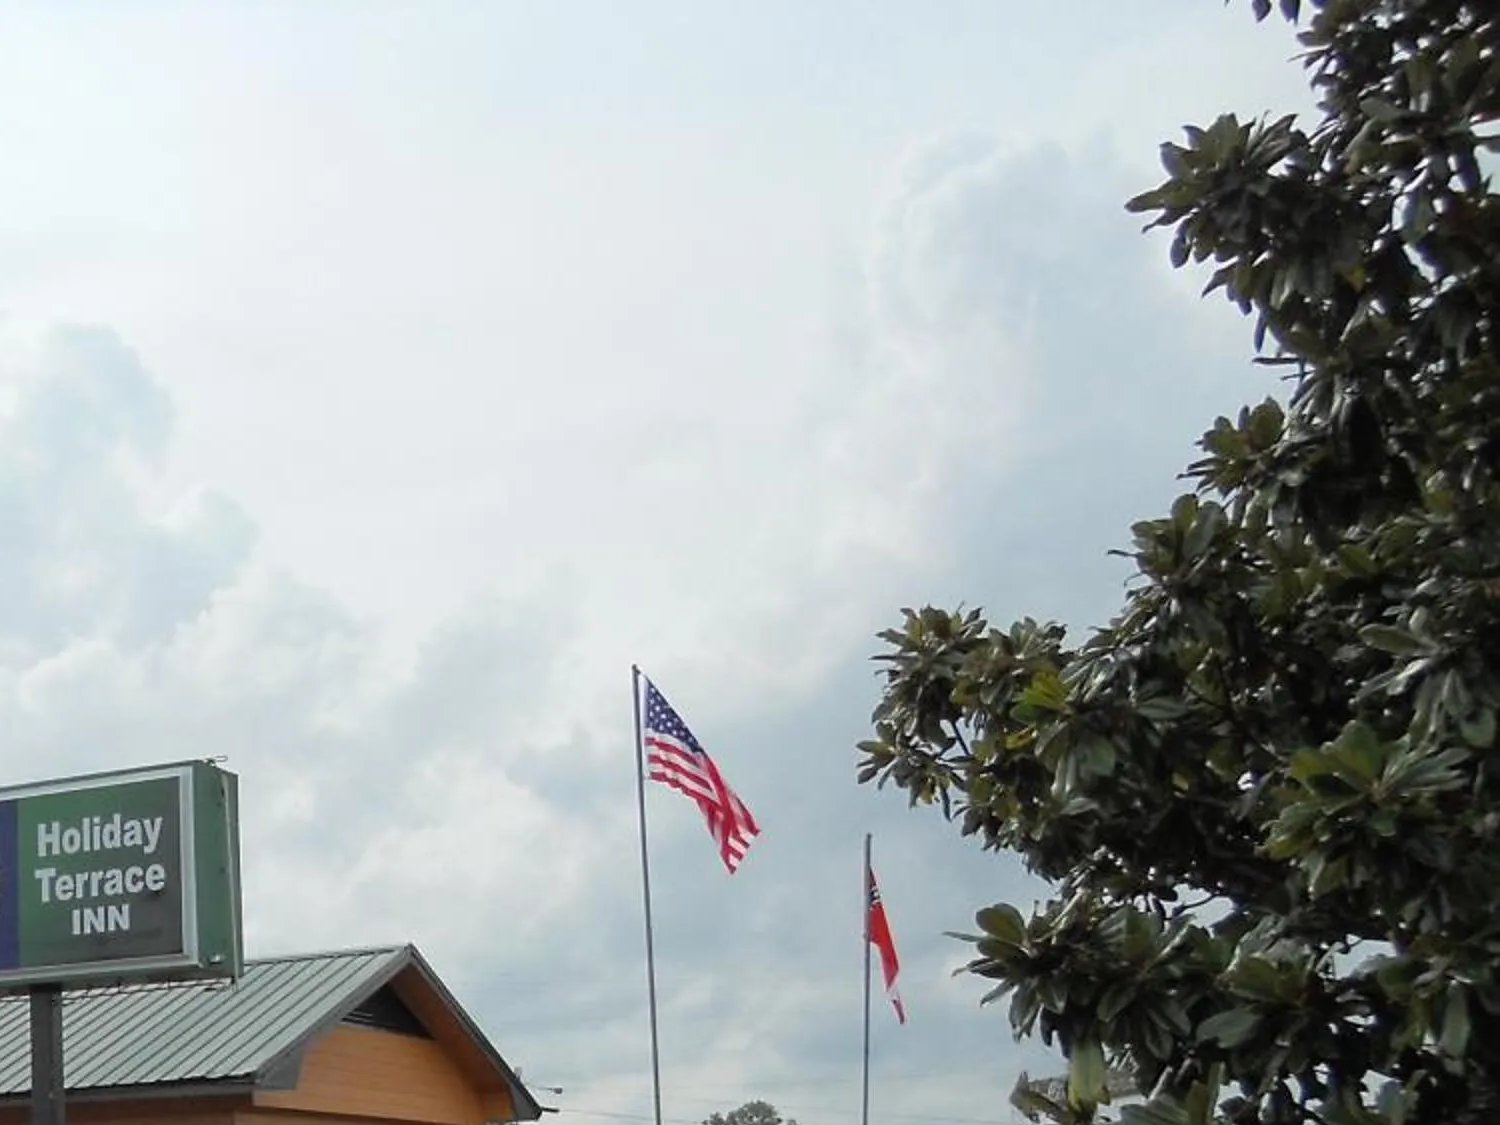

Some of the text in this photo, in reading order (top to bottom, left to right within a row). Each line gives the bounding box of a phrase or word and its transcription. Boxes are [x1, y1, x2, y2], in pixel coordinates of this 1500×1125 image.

[36, 813, 164, 857] Holiday
[34, 863, 166, 903] Terrace
[71, 904, 131, 935] INN
